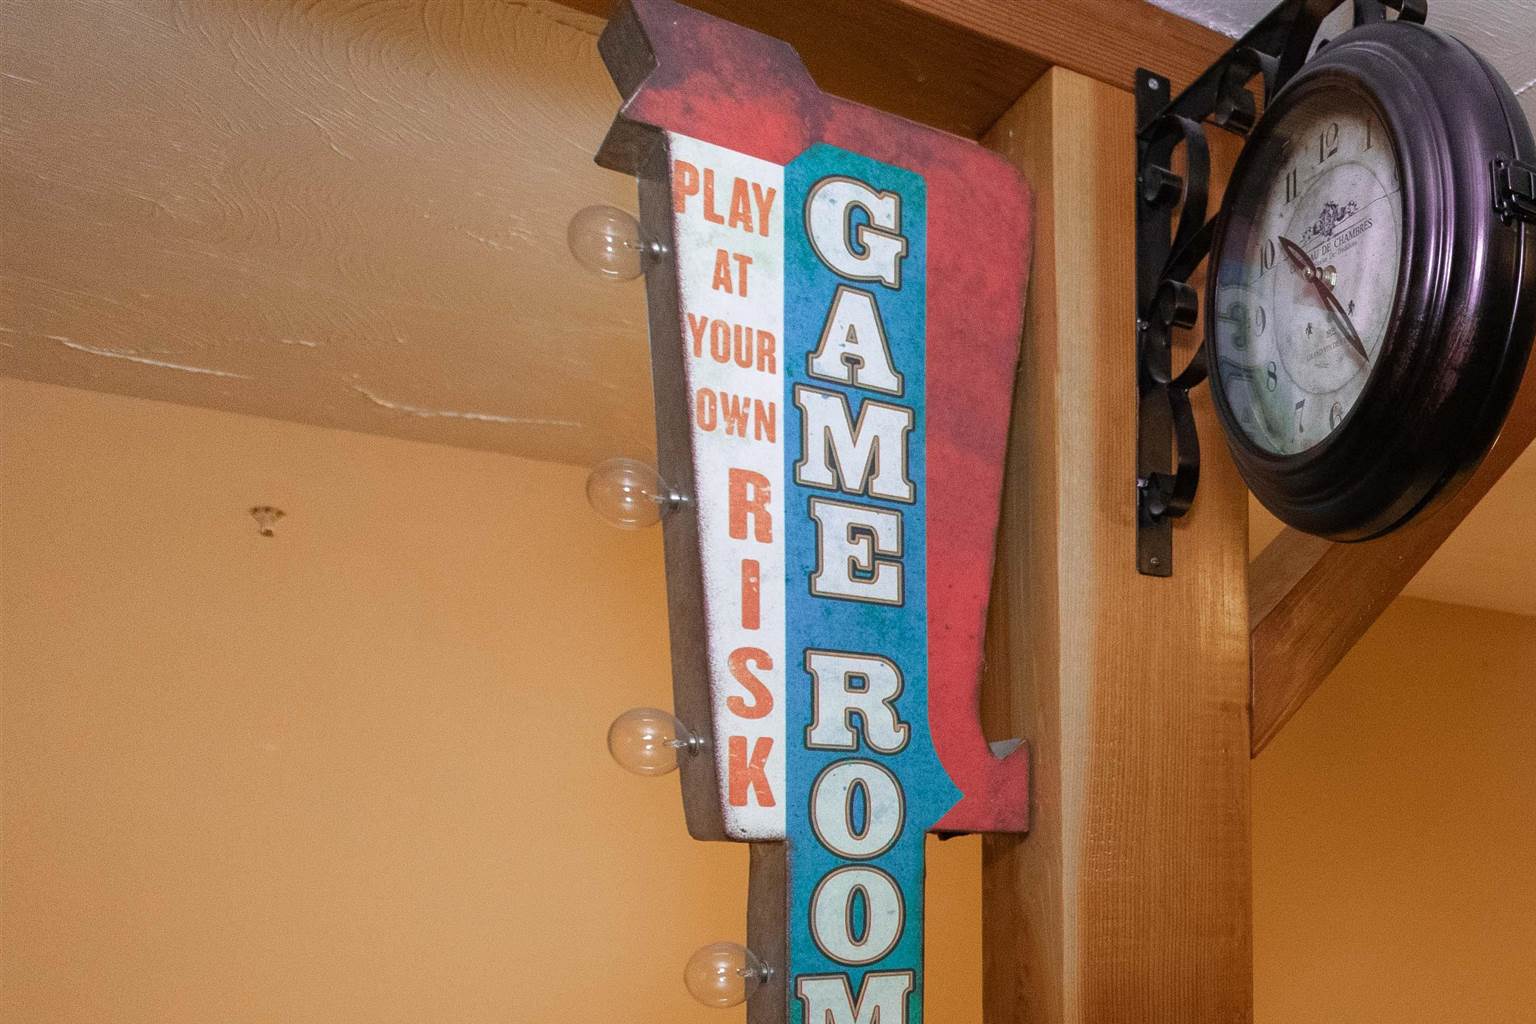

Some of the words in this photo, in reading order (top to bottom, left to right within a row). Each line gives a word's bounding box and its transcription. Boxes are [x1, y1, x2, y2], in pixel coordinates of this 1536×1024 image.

[1318, 122, 1339, 165] 12
[672, 159, 777, 237] PLAY
[1284, 167, 1302, 205] 11
[1333, 218, 1374, 249] CHAMBRES
[711, 248, 754, 298] AT
[1258, 238, 1276, 277] 10
[1255, 305, 1267, 337] 9
[686, 312, 777, 375] YOUR
[794, 174, 917, 608] GAME
[1265, 361, 1279, 393] 8
[695, 386, 777, 444] OWN
[1295, 398, 1306, 434] 7
[725, 467, 777, 808] RISK
